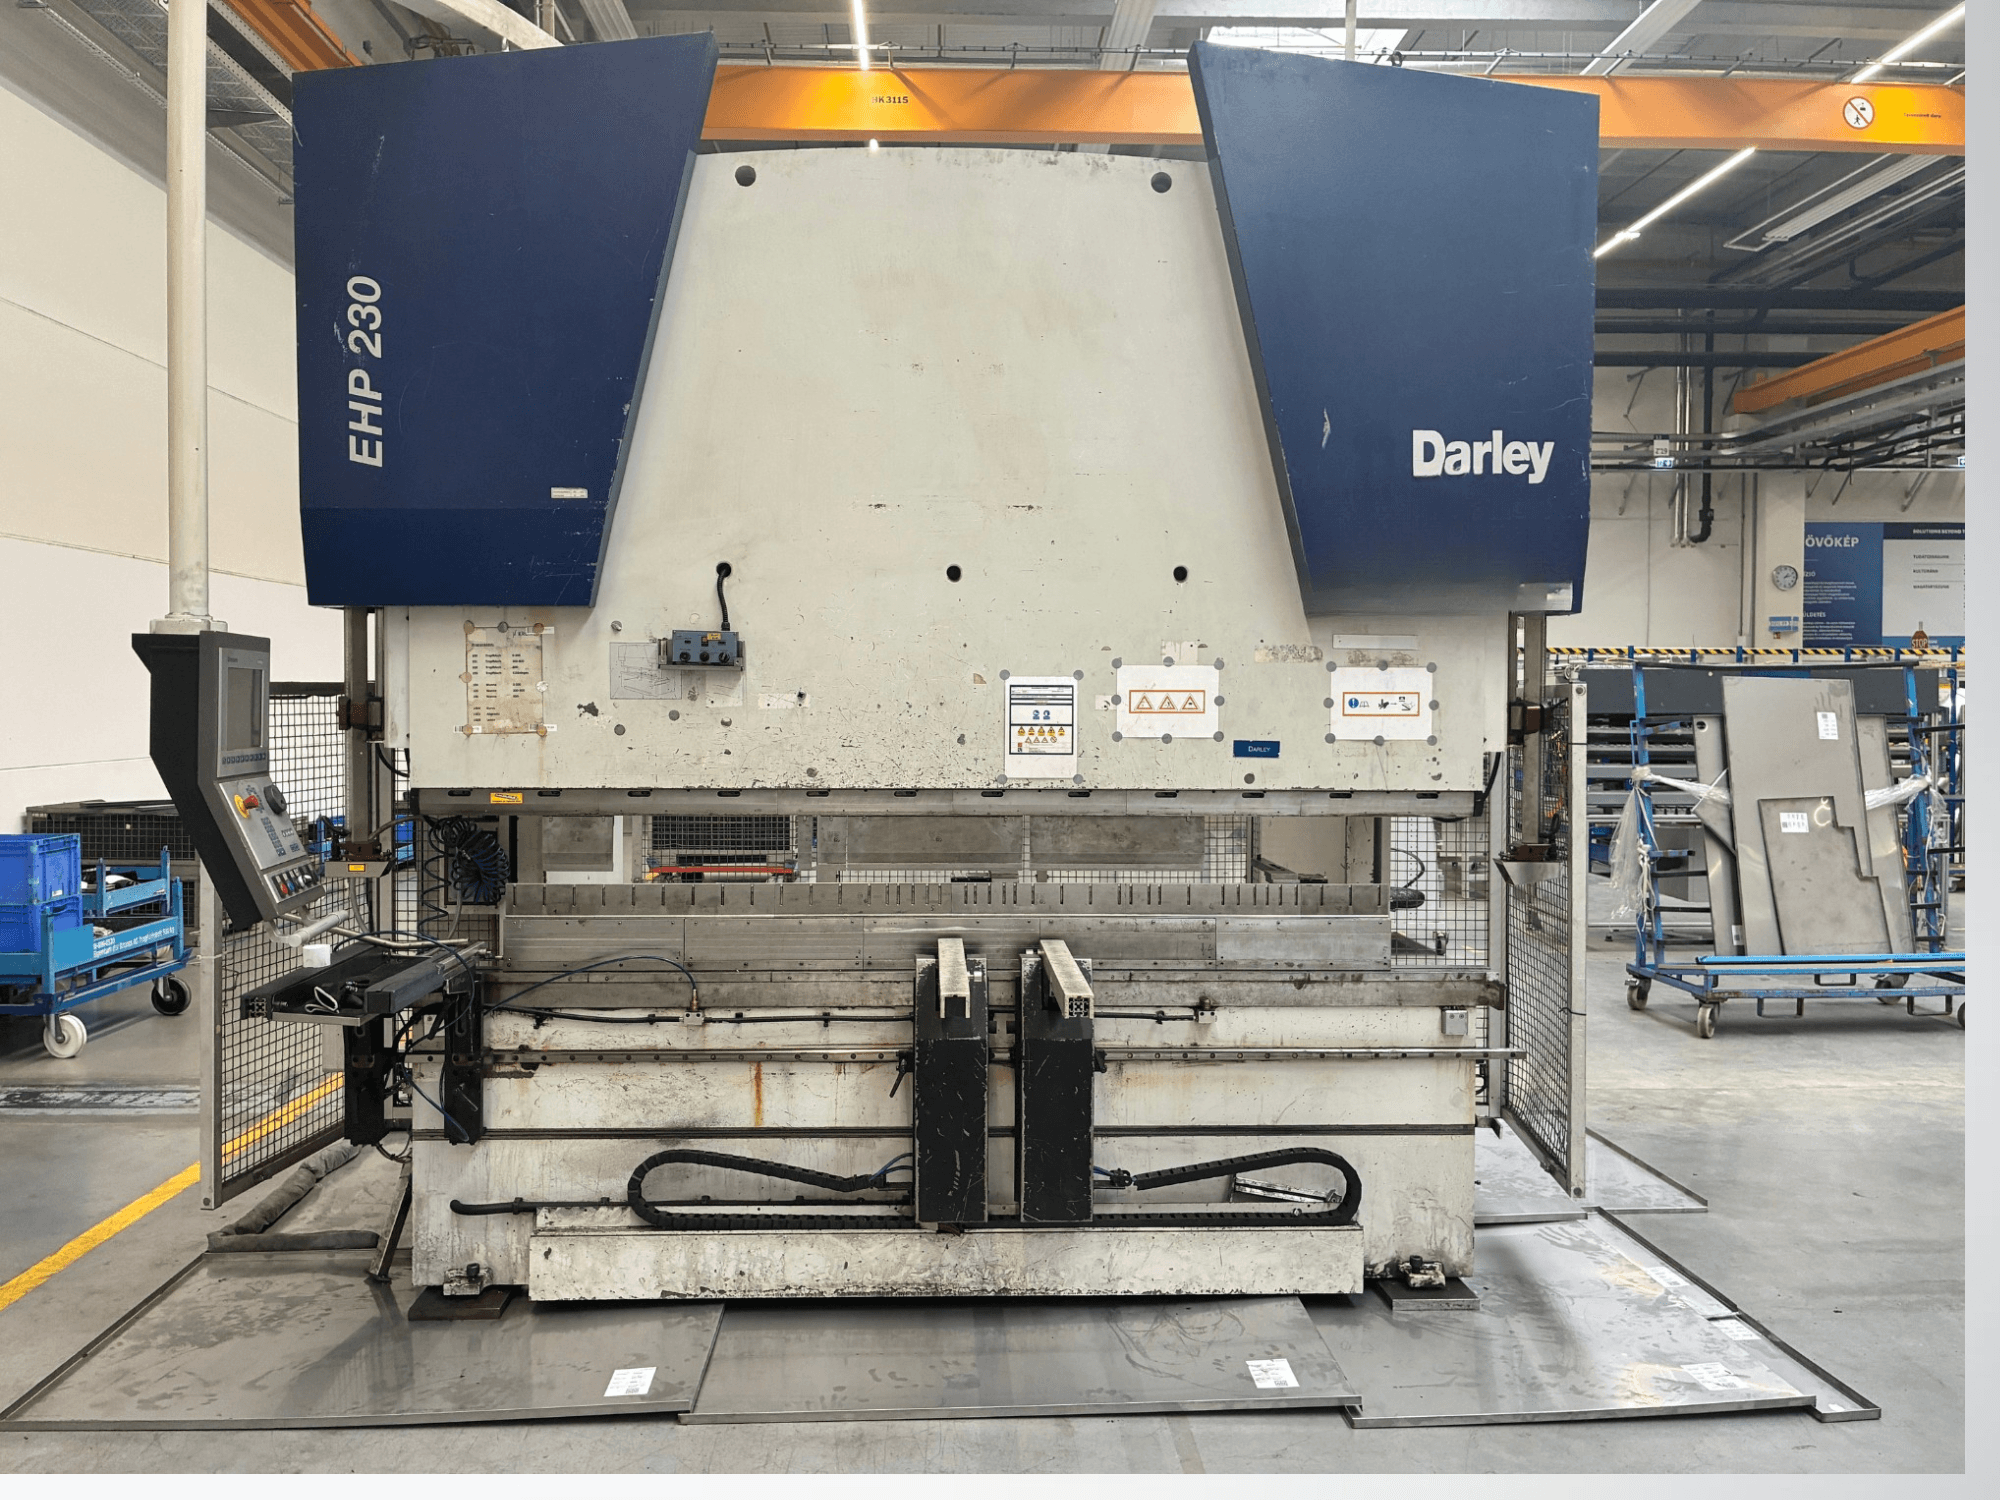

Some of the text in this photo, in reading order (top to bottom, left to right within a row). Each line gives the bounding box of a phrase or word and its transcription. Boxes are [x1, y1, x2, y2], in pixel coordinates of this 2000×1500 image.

[346, 275, 383, 468] EHP 230
[1412, 429, 1556, 485] Darley
[1804, 534, 1860, 548] ÖVŐKÉP
[1911, 638, 1928, 649] STOP
